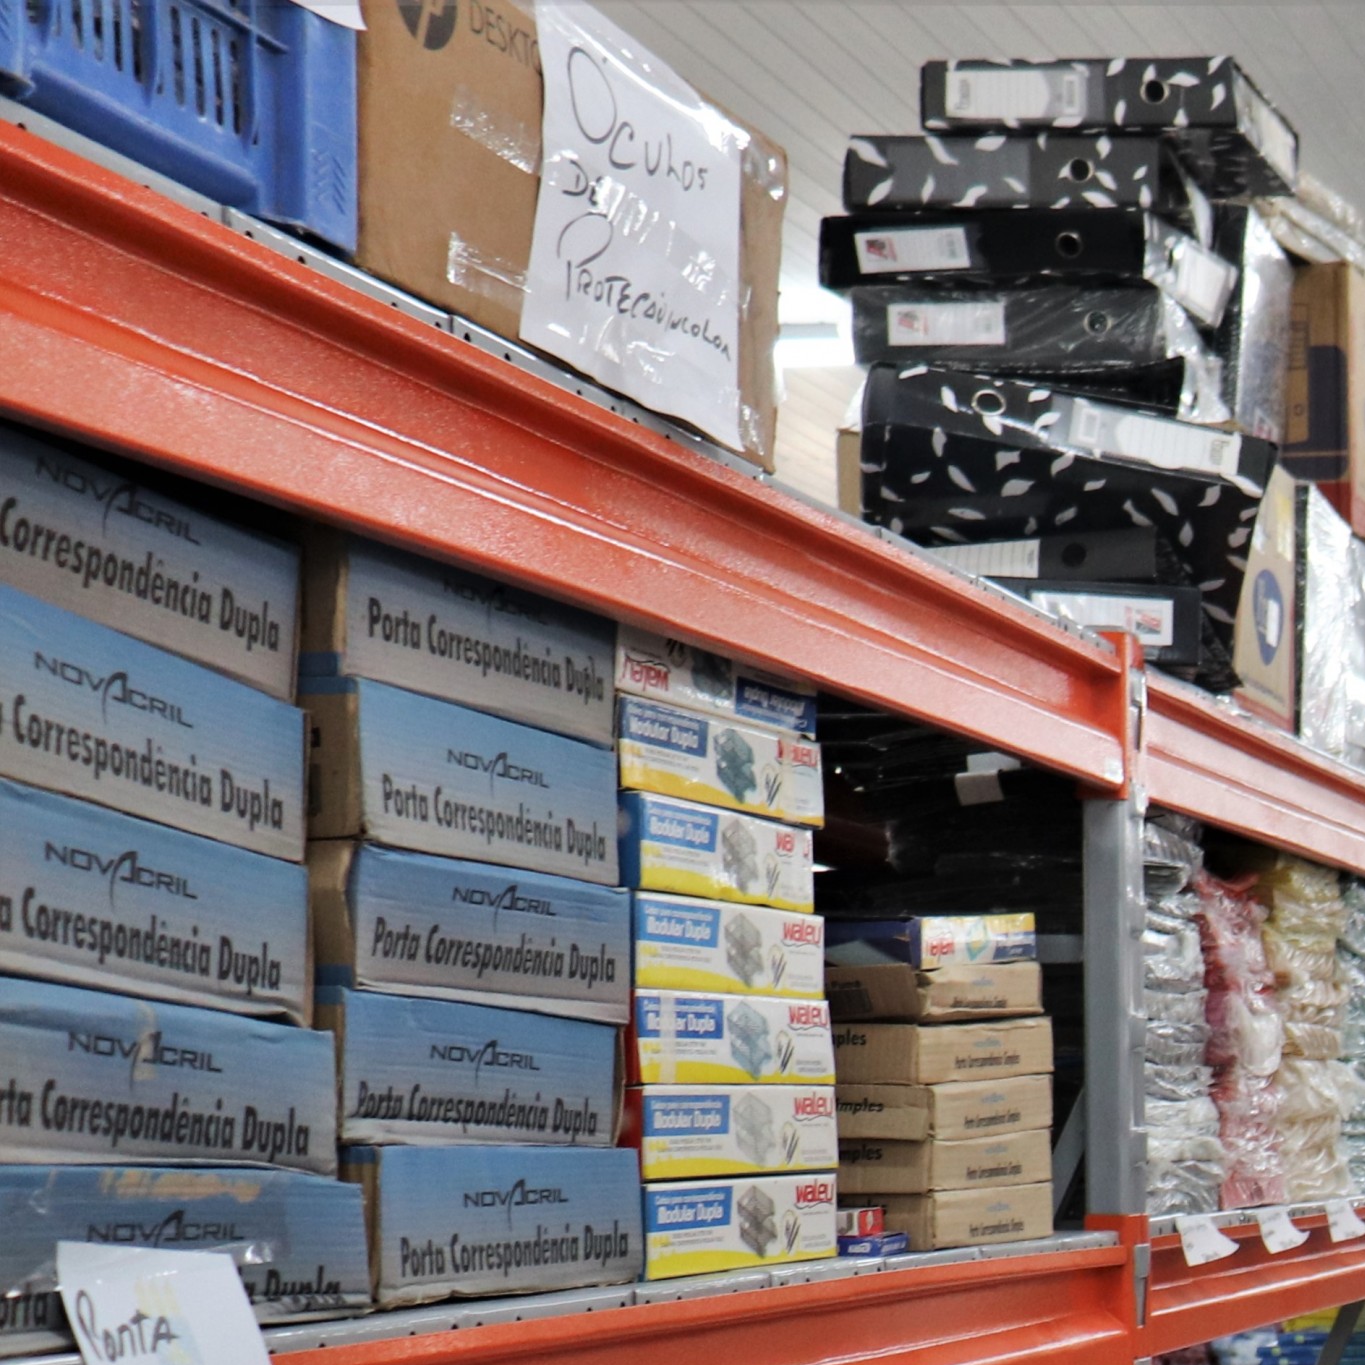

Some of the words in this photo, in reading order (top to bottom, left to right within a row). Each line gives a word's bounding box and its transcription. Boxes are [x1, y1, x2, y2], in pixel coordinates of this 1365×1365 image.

[220, 586, 280, 653] Dupla
[368, 596, 421, 651] Porta
[427, 613, 562, 690] Correspondência
[565, 654, 605, 705] Dupla
[34, 650, 194, 727] NOVACRIL
[13, 694, 213, 808] Correspondência
[220, 768, 284, 831] Dupla
[447, 748, 550, 799] NOVACRIL
[382, 773, 429, 821] Porta
[434, 785, 563, 852] Correspondência
[566, 817, 607, 866] Dupla
[45, 840, 198, 912] NOVACRIL
[452, 885, 557, 934] NOVACRIL
[22, 886, 212, 980] Correspondência
[217, 935, 282, 993] Dupla
[372, 916, 421, 960] Porta
[425, 923, 564, 980] Correspondência
[569, 942, 617, 989] Dupla
[68, 1030, 223, 1092] NOVACRIL
[430, 1039, 541, 1087] NOVACRIL
[40, 1078, 235, 1147] Correspondência
[242, 1103, 311, 1162] Dupla
[352, 1081, 404, 1121] Porta
[407, 1083, 548, 1132] Correspondência
[551, 1096, 599, 1142] Dupla
[87, 1209, 246, 1248] NOVACRIL
[463, 1179, 570, 1230] NOVACRIL
[400, 1236, 446, 1277] Porta
[450, 1223, 580, 1276] Correspondência
[583, 1219, 630, 1271] Dupla
